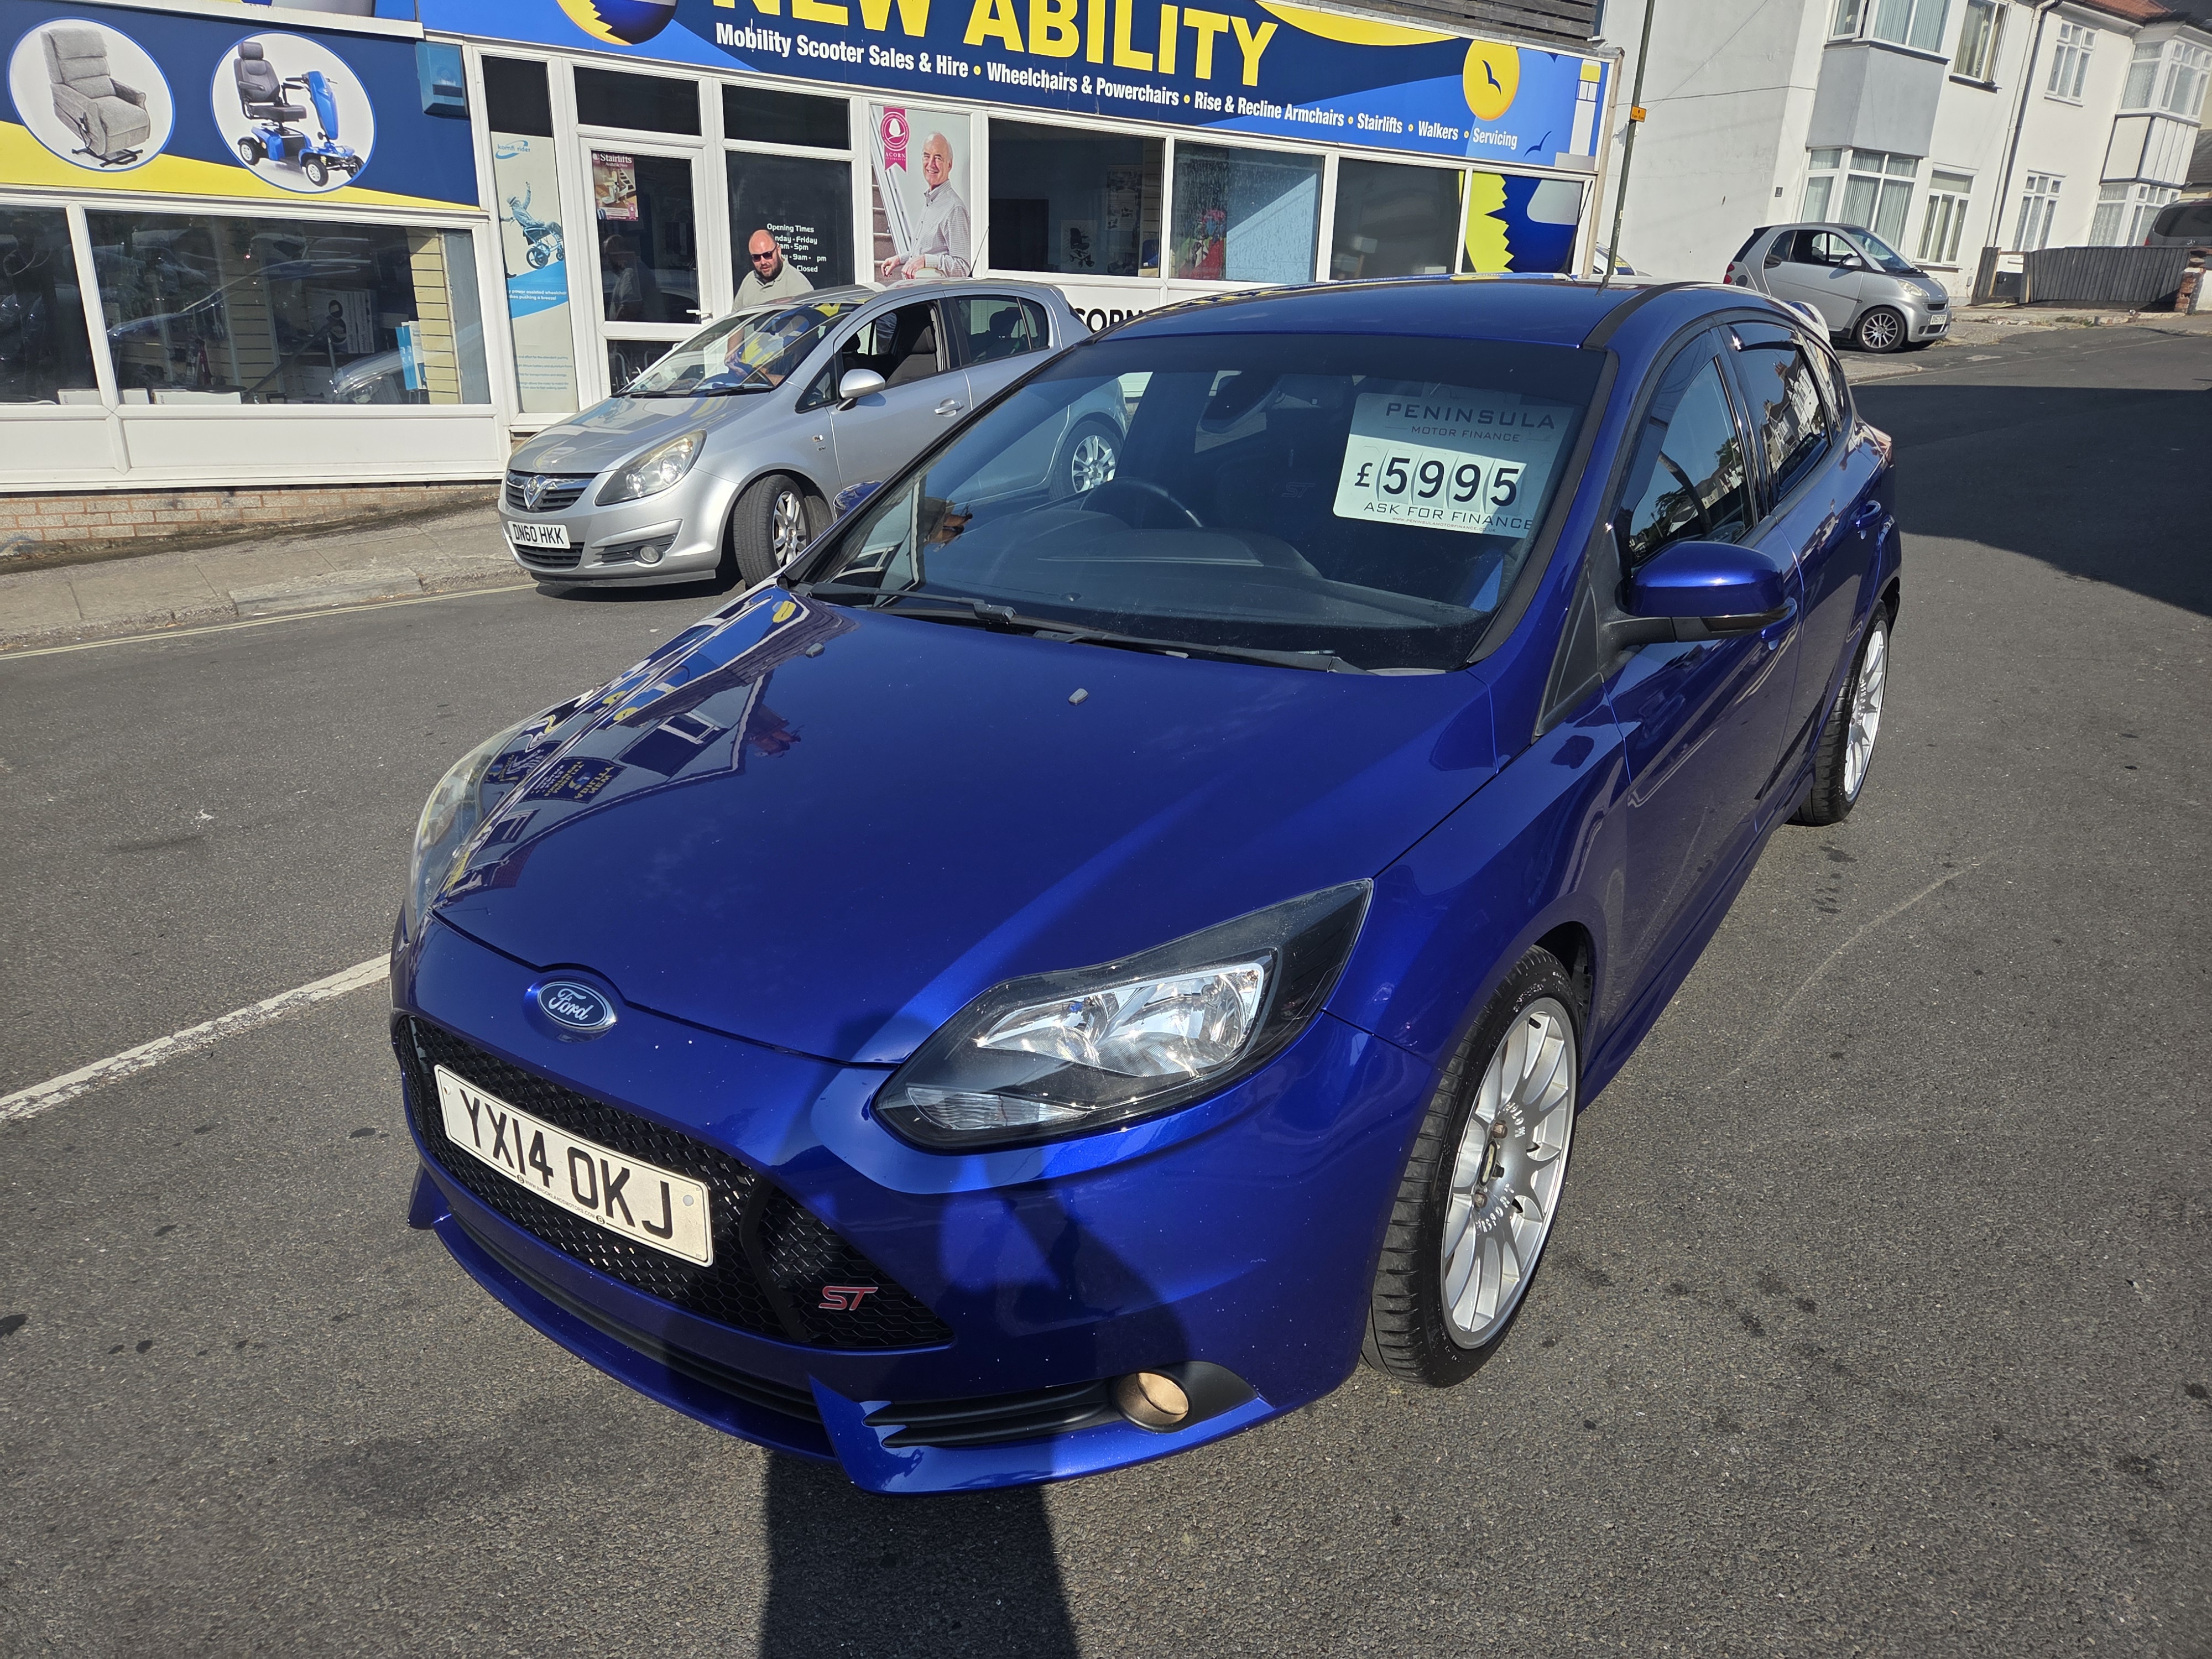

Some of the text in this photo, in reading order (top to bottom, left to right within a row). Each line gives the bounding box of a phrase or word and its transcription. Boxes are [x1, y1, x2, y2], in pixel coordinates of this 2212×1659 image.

[963, 0, 1278, 86] ABILITY
[717, 22, 1517, 150] Mobility Scooter Sales & Hire Wheelchairs & Powerchairs Rise & Recline Armchairs Stairlifts Walkers Servicing
[600, 153, 632, 164] Stairlifts
[767, 223, 794, 232] Opening
[796, 236, 817, 244] Friday
[1385, 403, 1554, 429] PENINSULA
[1411, 426, 1521, 442] MOTOR FINANCE
[1281, 482, 1316, 498] ST
[1364, 502, 1533, 530] ASK FOR FINANCE
[1392, 517, 1496, 533] WWW.PENINSULAMOTORFINANCE.CO.UK
[512, 524, 564, 544] DN60 HKK
[549, 988, 594, 1020] Ford
[459, 1088, 673, 1240] YX14 OKJ
[525, 1180, 595, 1218] WWW.BROOKLANDSMOTORS.COM
[818, 1286, 878, 1311] ST
